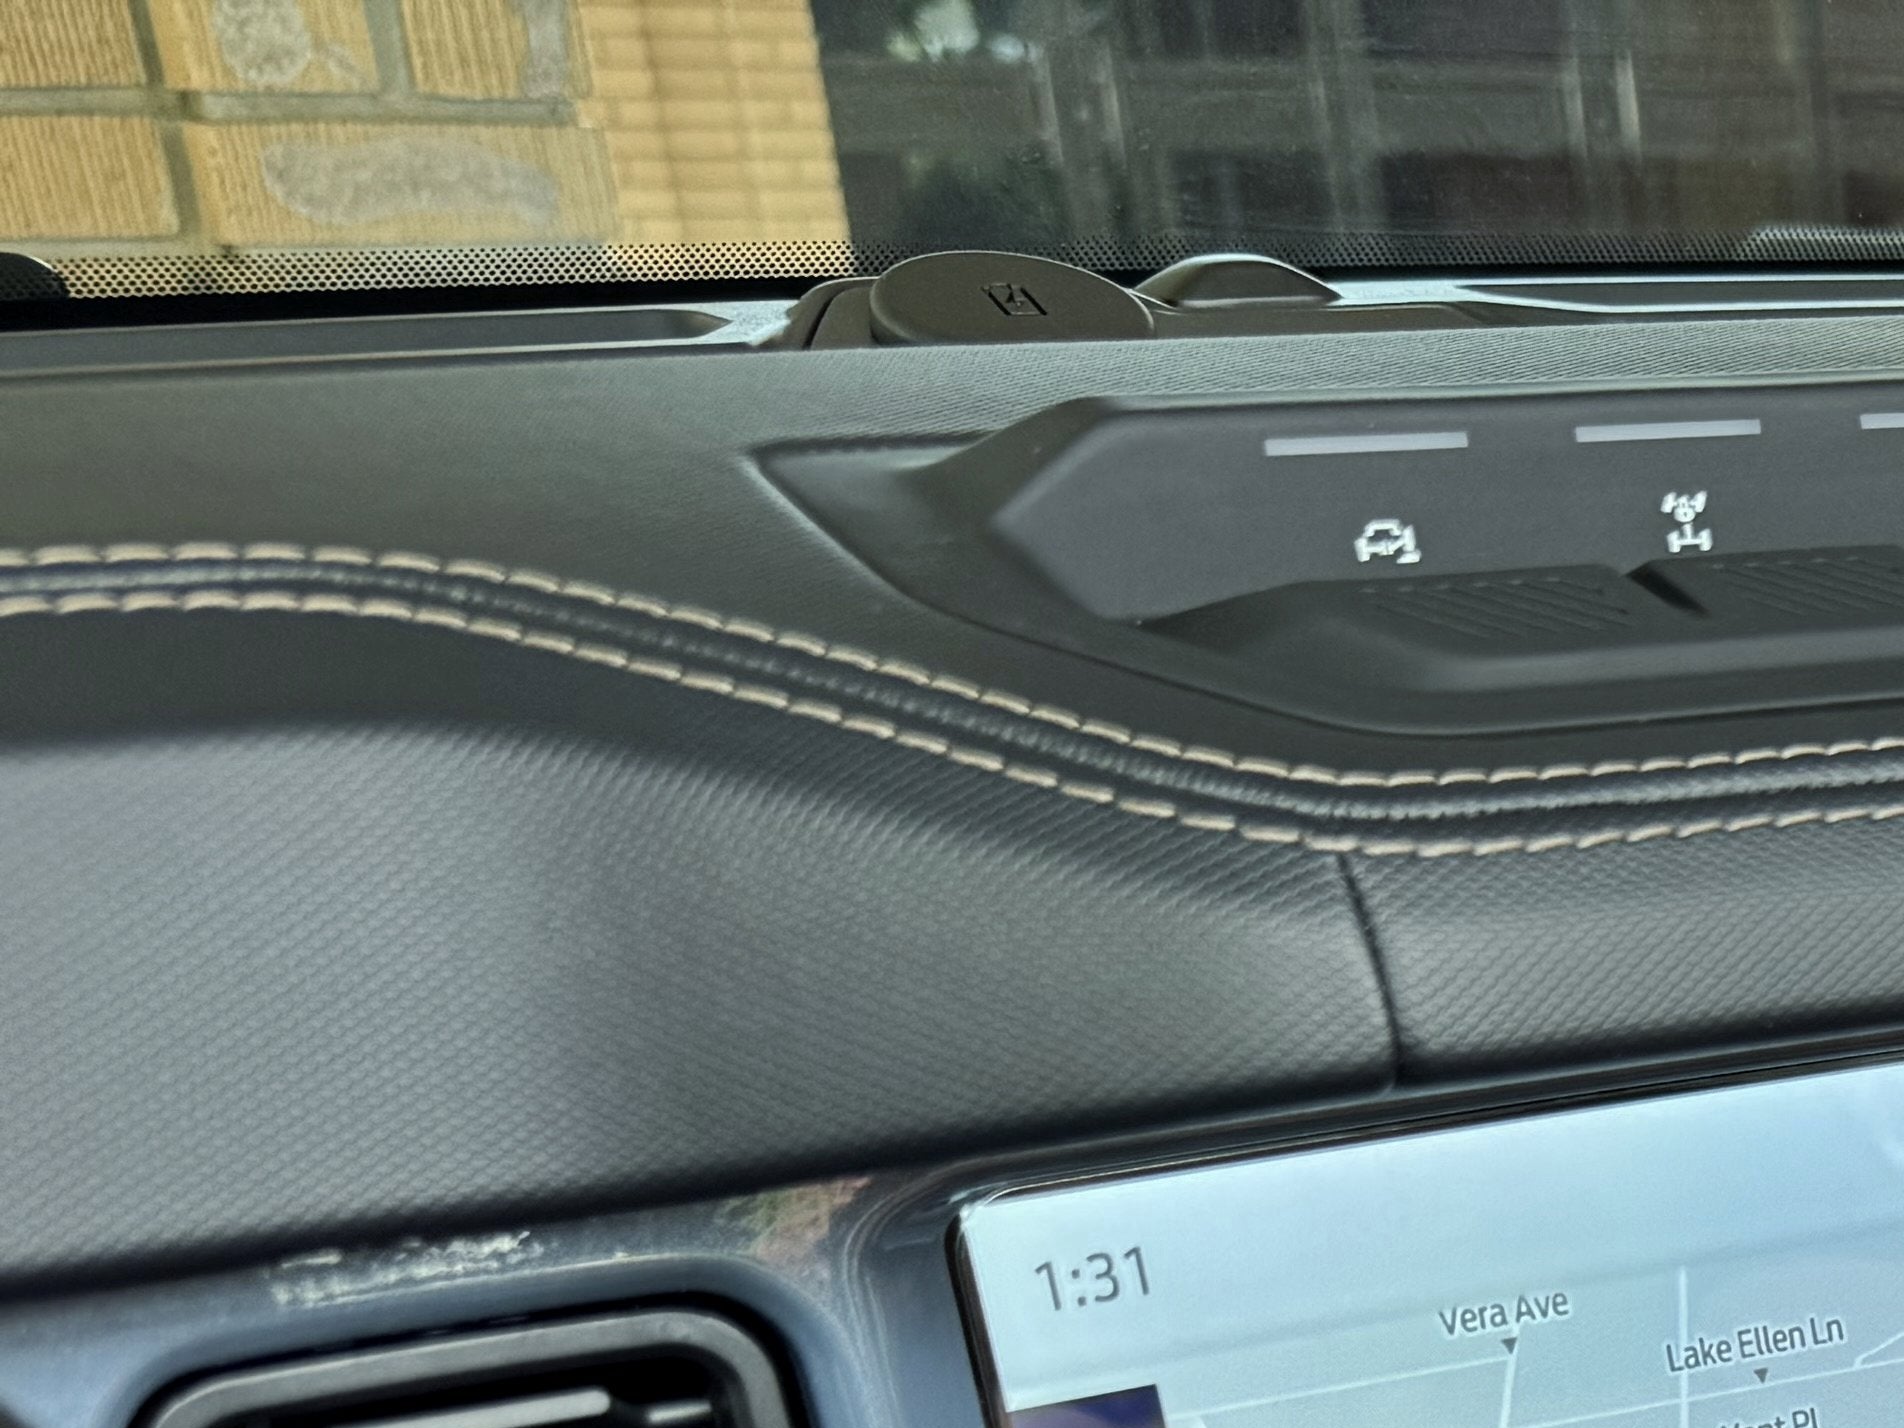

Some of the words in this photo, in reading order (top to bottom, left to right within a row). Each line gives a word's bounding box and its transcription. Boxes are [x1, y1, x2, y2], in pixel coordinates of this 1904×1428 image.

[1033, 1245, 1153, 1313] 1:31
[1438, 1297, 1508, 1338] Vera
[1513, 1289, 1571, 1327] Ave
[1665, 1335, 1733, 1374] Lake
[1736, 1322, 1802, 1361] Ellen
[1807, 1315, 1846, 1347] Ln
